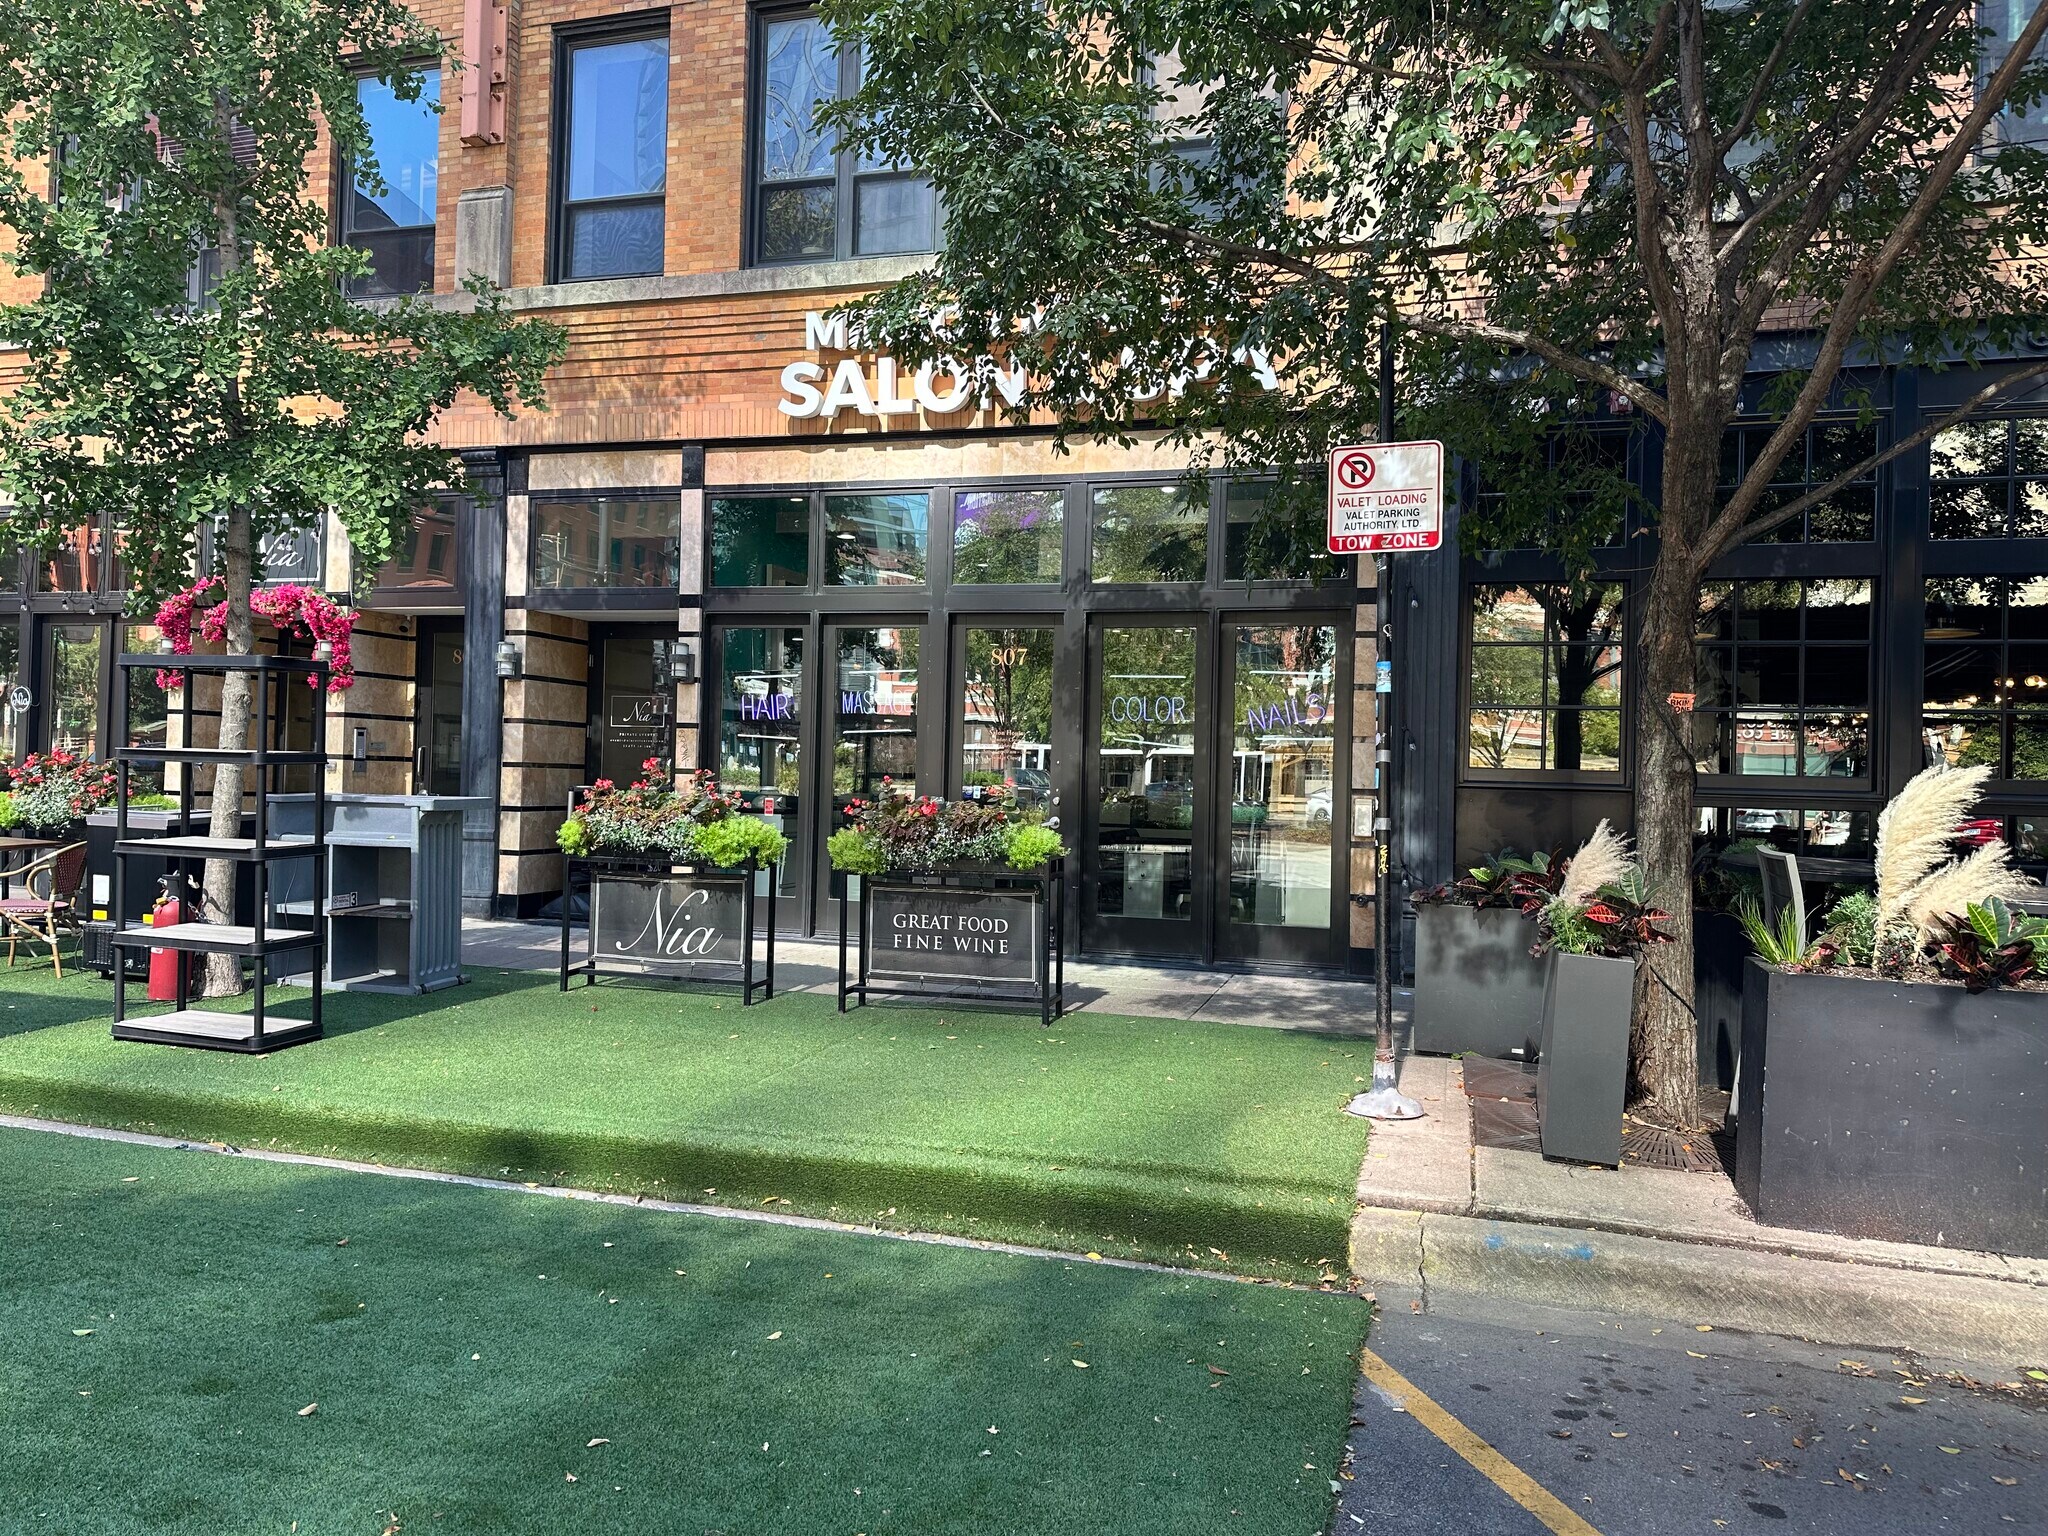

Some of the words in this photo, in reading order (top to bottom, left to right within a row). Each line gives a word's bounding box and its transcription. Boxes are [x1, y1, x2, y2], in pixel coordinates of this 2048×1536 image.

[779, 356, 1029, 419] SALON
[1337, 496, 1372, 508] VALET
[1378, 493, 1428, 506] LOADING
[1345, 510, 1375, 520] VALET
[1378, 508, 1420, 518] PARKING
[1336, 536, 1372, 550] TOW
[1381, 533, 1429, 548] ZONE
[990, 648, 1028, 666] 807
[622, 701, 652, 722] Nia
[741, 693, 792, 721] HAIR
[842, 690, 915, 715] MASSAGE
[1111, 696, 1186, 722] COLOR
[1247, 693, 1326, 734] NAILS
[351, 893, 356, 905] 3
[615, 887, 724, 955] Nia
[893, 913, 952, 930] GREAT
[958, 916, 1008, 934] FOOD
[894, 934, 943, 950] FINE
[953, 936, 1009, 954] WINE
